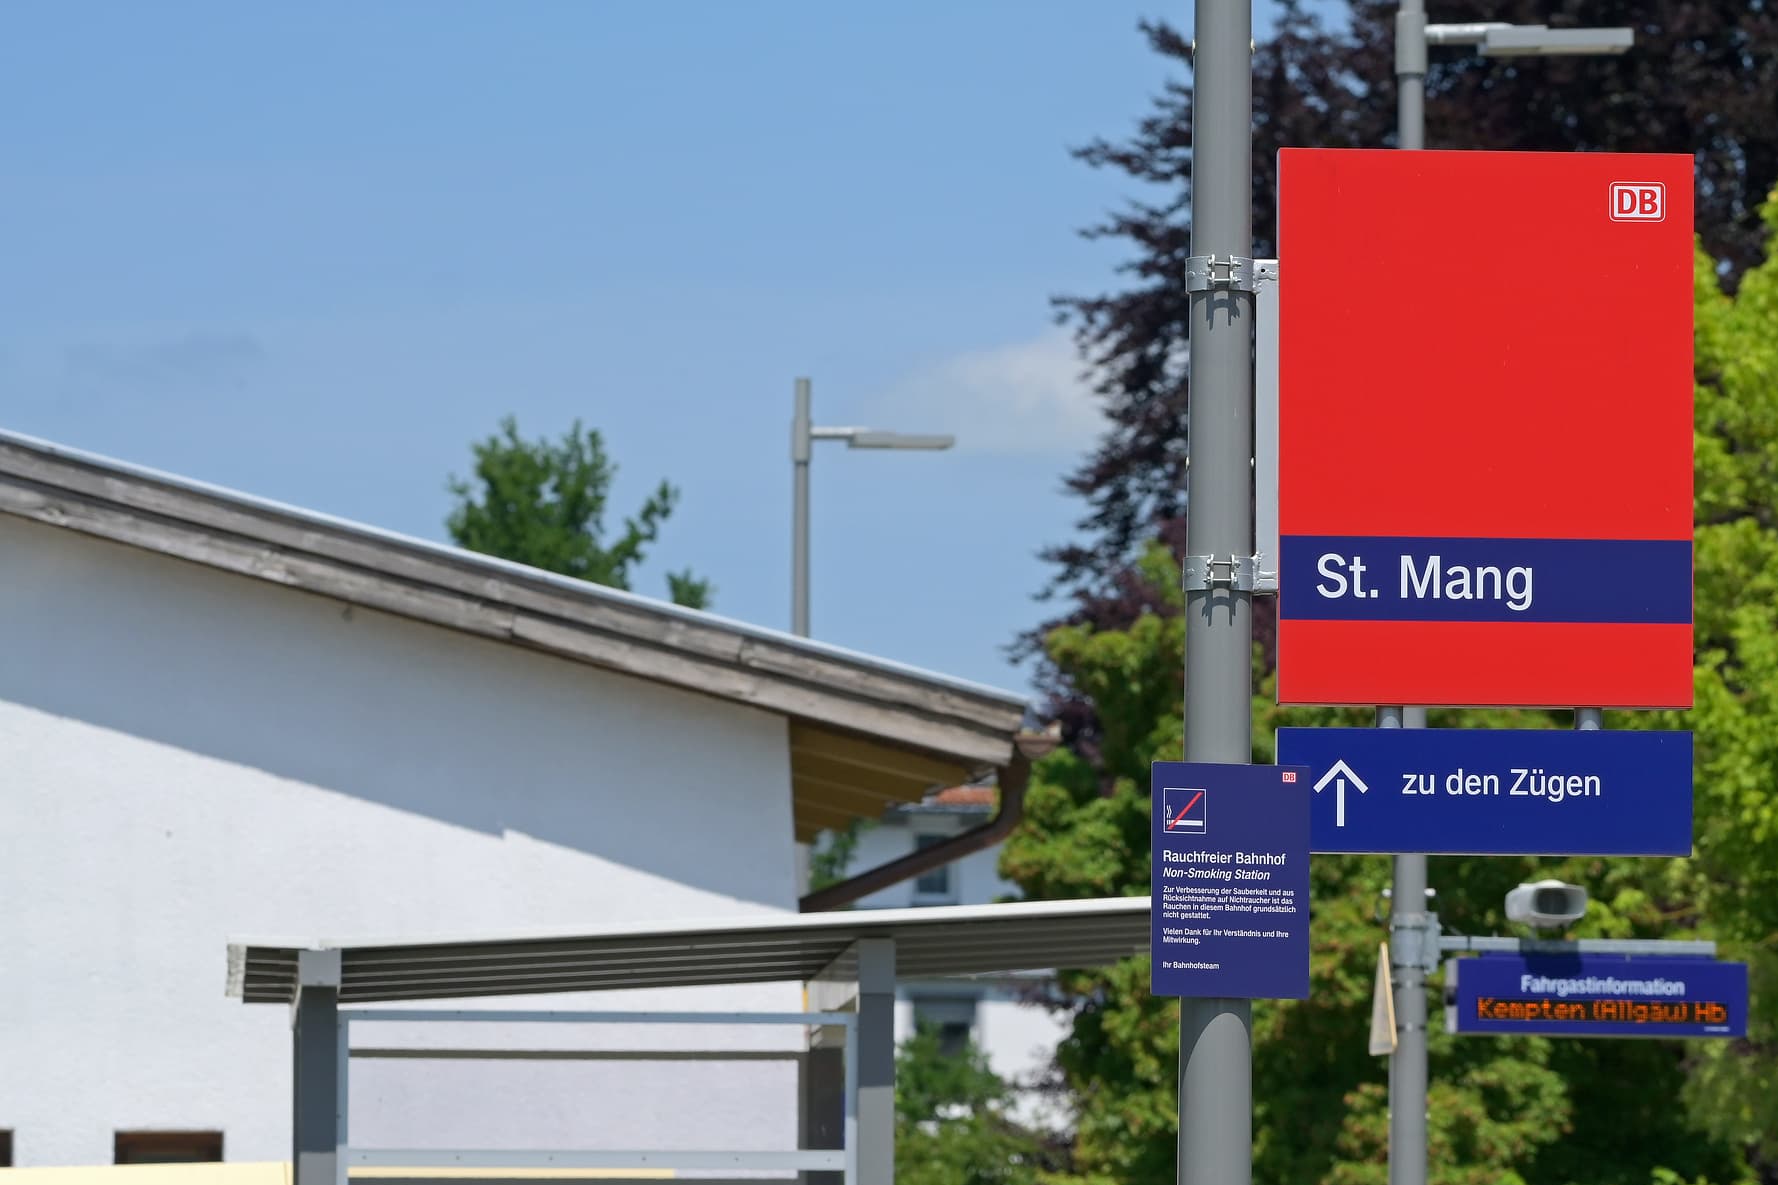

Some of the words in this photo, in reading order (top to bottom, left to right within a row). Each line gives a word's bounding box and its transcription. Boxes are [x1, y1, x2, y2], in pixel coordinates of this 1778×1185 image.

[1617, 188, 1658, 215] DB
[1316, 552, 1379, 599] St.
[1400, 554, 1534, 611] Mang
[1402, 774, 1435, 795] zu
[1445, 768, 1500, 796] den
[1509, 768, 1601, 803] Zügen
[1162, 849, 1233, 864] Rauchfreier
[1235, 851, 1286, 866] Bahnhof
[1162, 867, 1232, 882] Non-Smoking
[1234, 869, 1271, 881] Station
[1175, 886, 1220, 896] Verbesserung
[1220, 887, 1232, 895] der
[1268, 888, 1281, 896] und
[1162, 902, 1192, 910] Rauchen
[1199, 903, 1224, 911] diesem
[1224, 904, 1252, 912] Bahnhof
[1162, 911, 1180, 919] nicht
[1184, 928, 1201, 936] Dank
[1262, 930, 1275, 938] und
[1520, 974, 1686, 997] Fahrgastinformation
[1477, 997, 1587, 1021] Kempten
[1694, 1002, 1727, 1023] Hb
